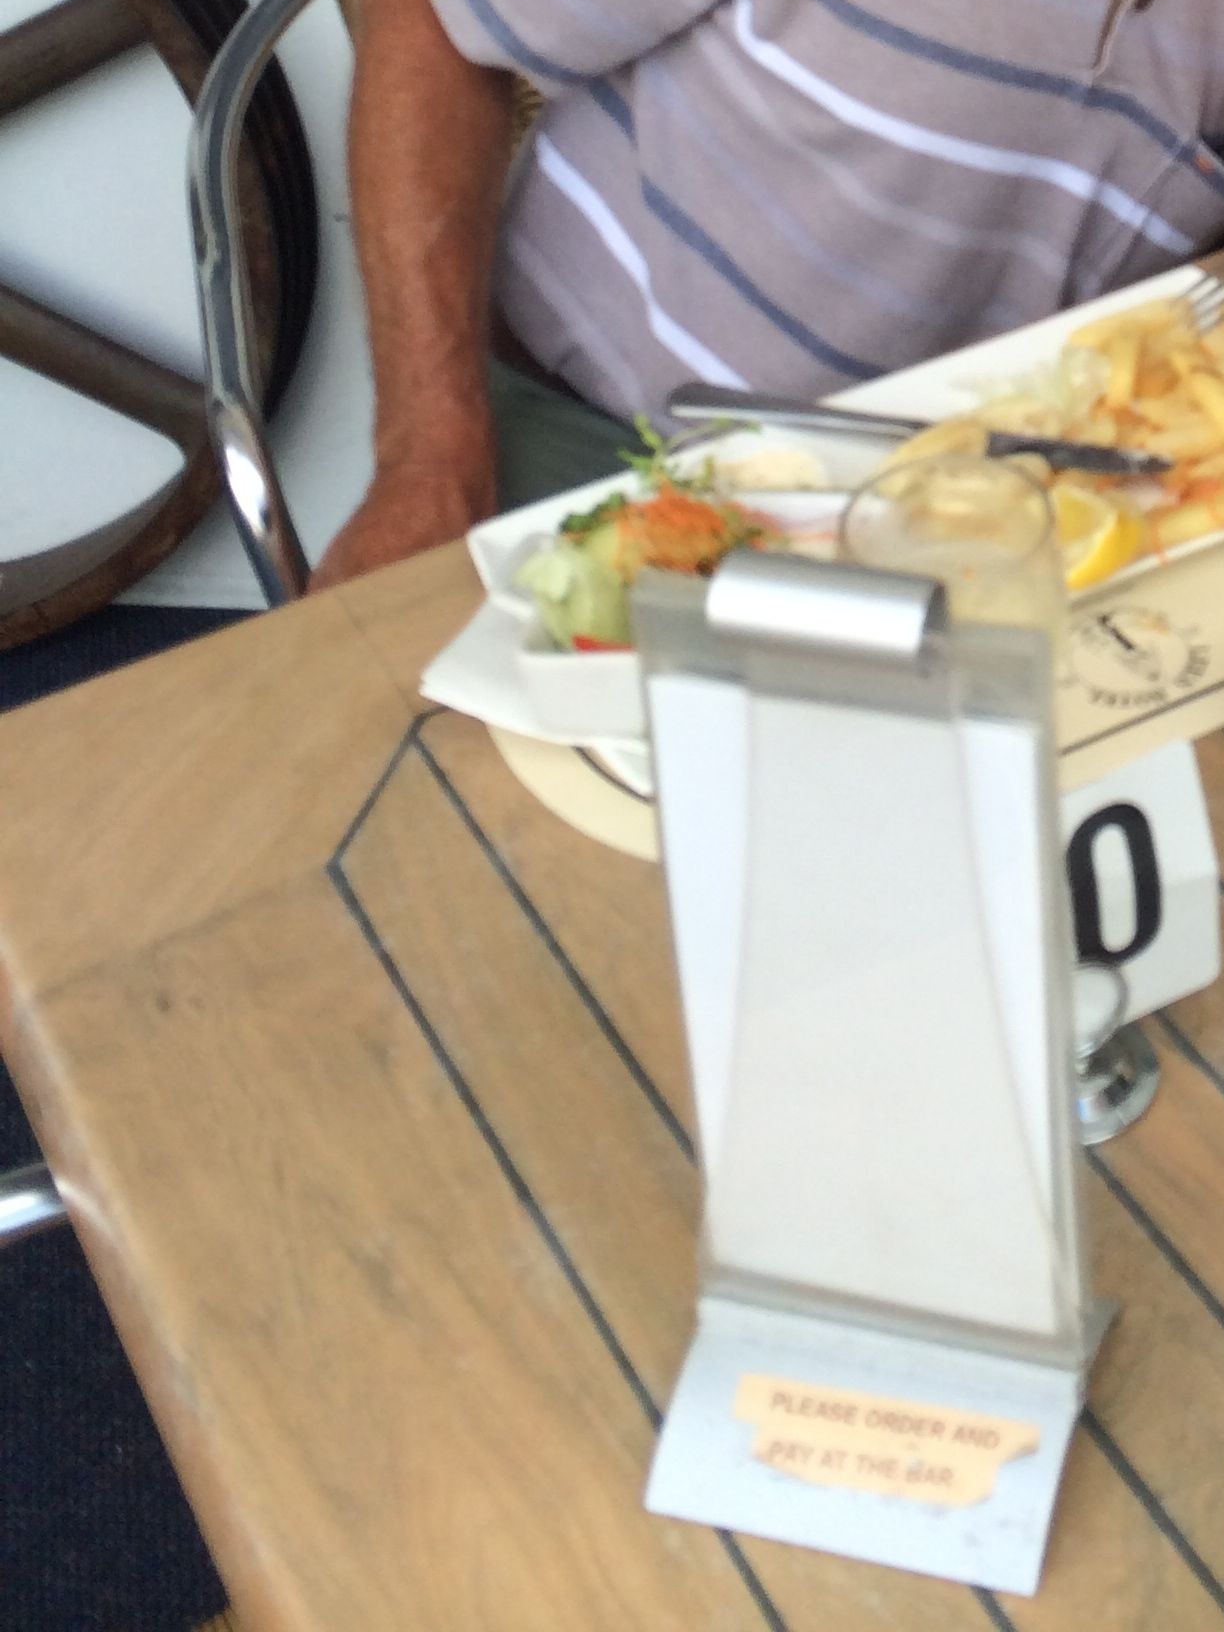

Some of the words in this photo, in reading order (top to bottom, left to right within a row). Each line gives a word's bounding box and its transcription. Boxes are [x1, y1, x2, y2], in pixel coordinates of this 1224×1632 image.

[770, 1389, 858, 1427] PLEASE
[865, 1408, 946, 1440] ORDER
[952, 1424, 1001, 1450] AND
[767, 1440, 817, 1468] PAY
[820, 1447, 849, 1472] AT
[856, 1453, 898, 1480] THE
